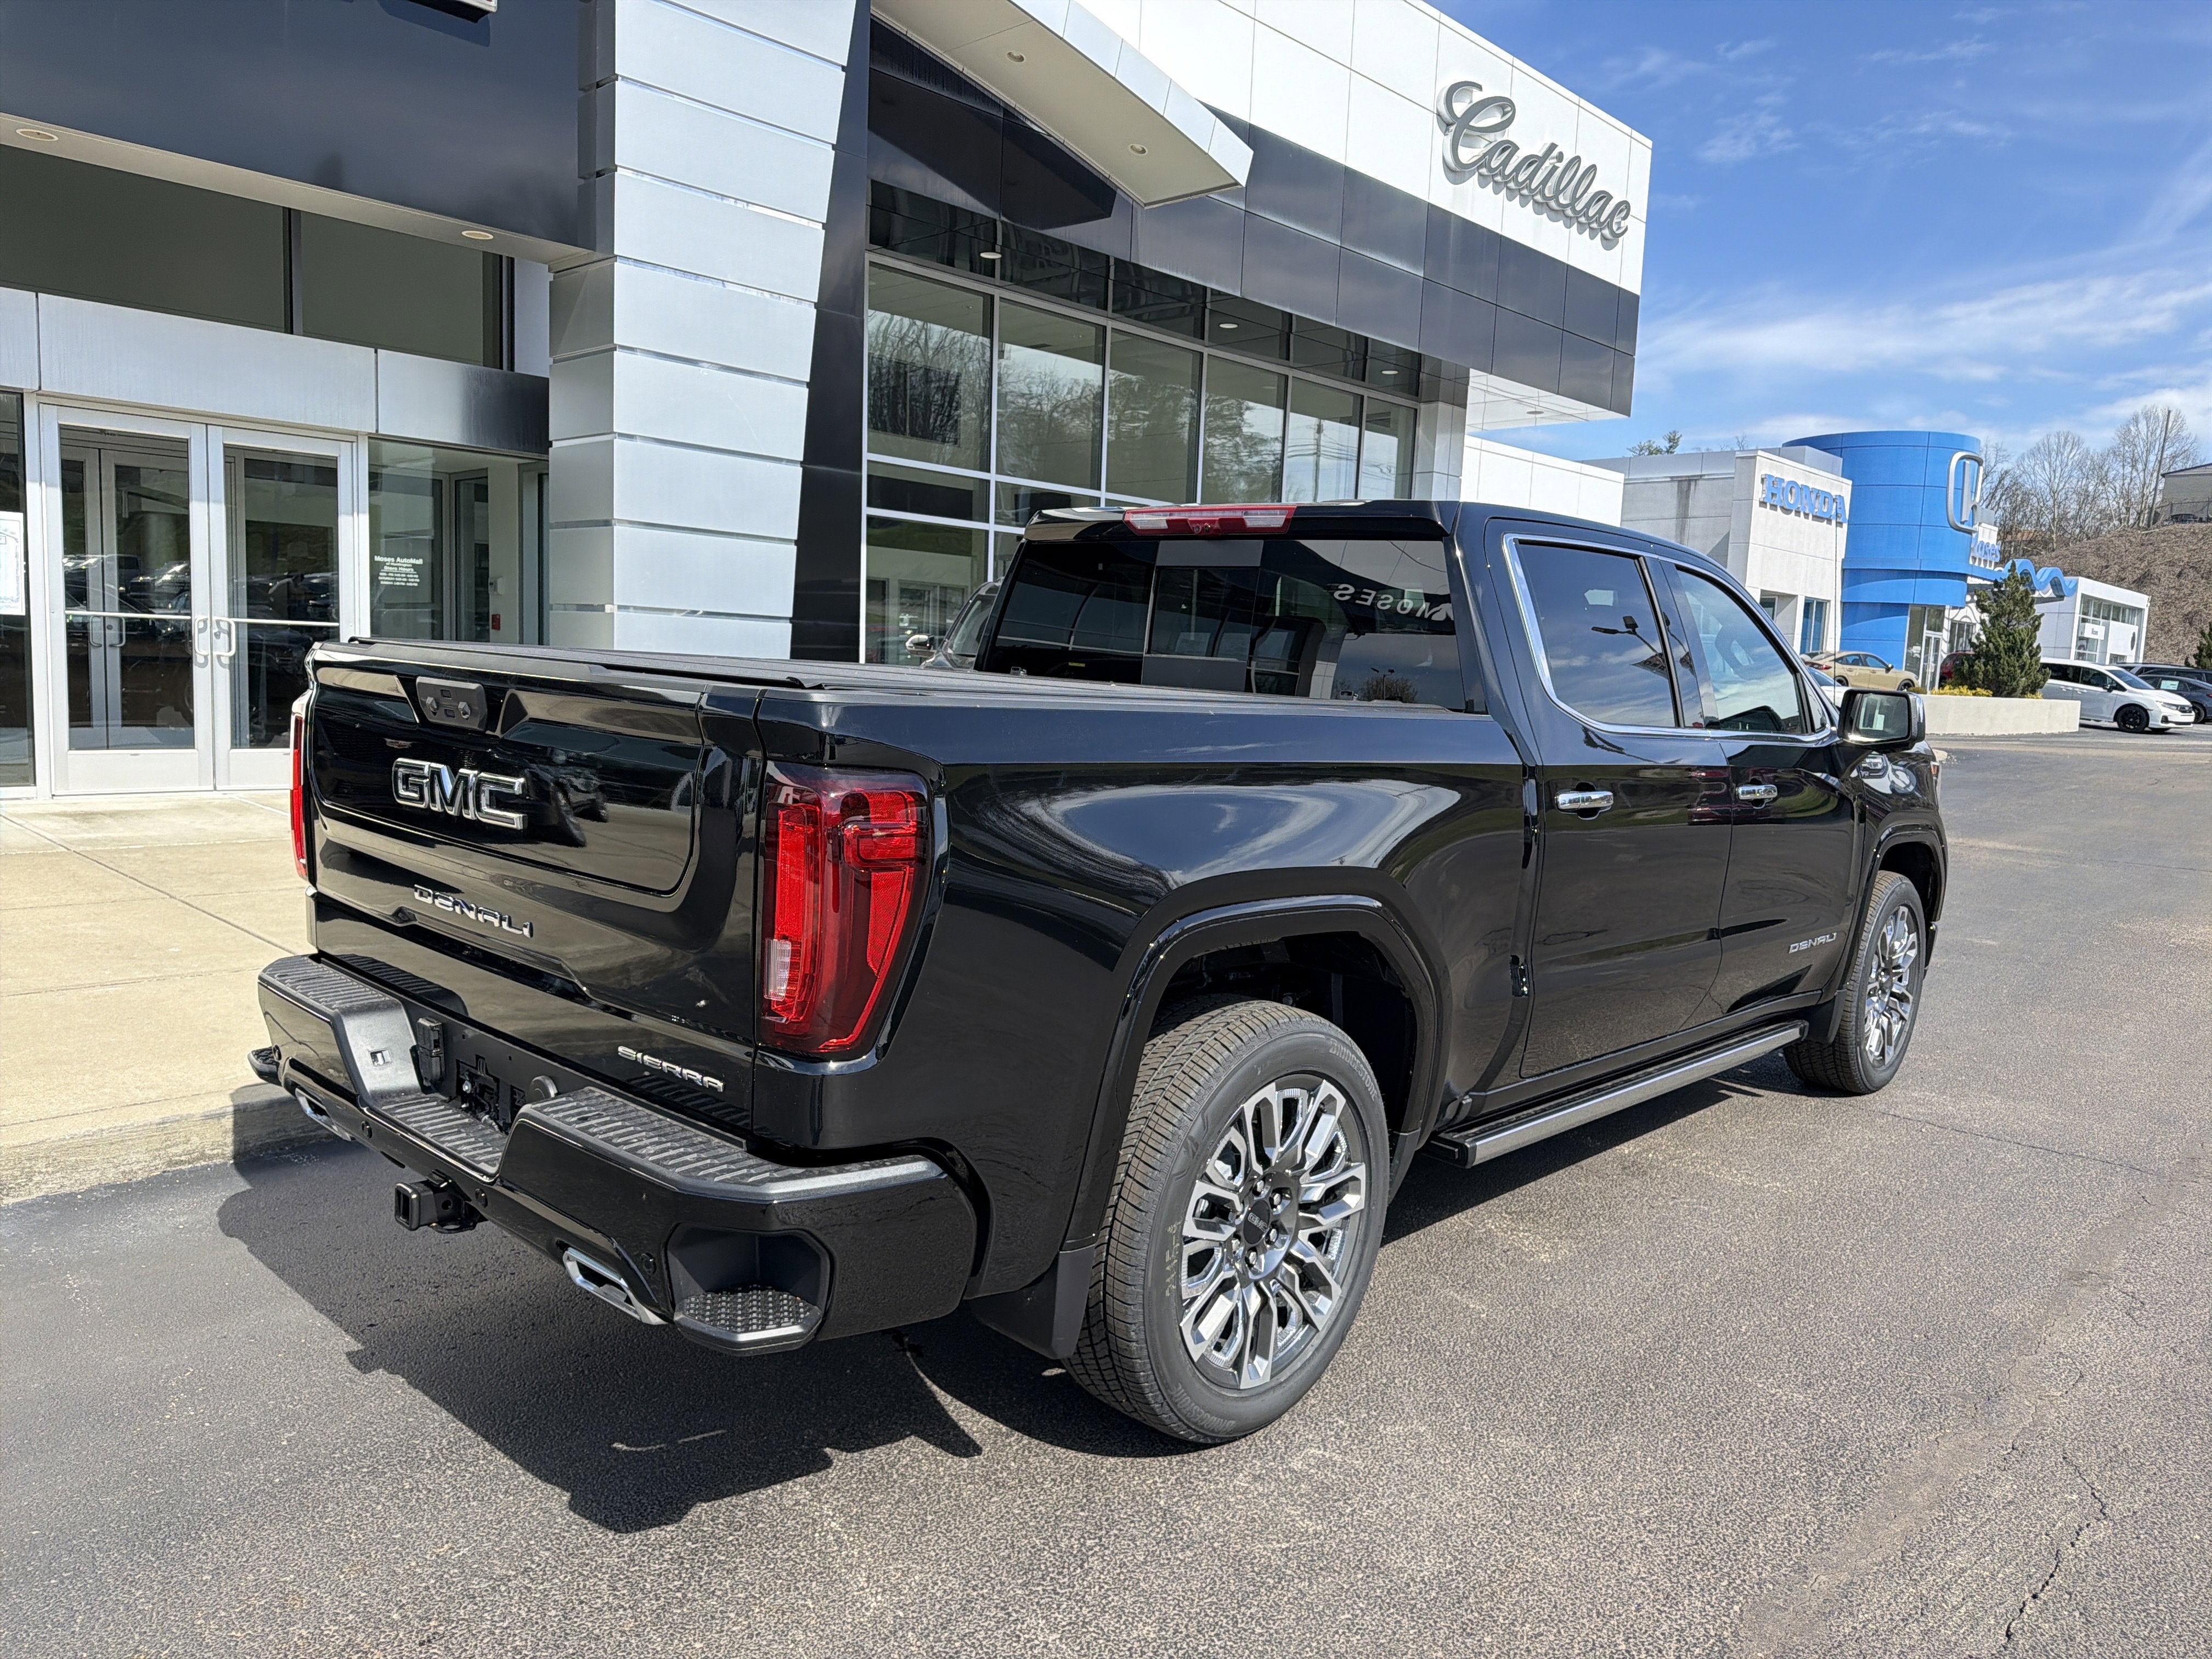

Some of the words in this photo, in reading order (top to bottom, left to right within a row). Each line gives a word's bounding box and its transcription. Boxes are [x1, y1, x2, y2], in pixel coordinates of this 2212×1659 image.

[1437, 81, 1631, 239] Cadillac
[1760, 474, 1848, 524] HONDA
[392, 758, 528, 830] GMC
[414, 884, 534, 939] DENALI
[1788, 932, 1837, 954] DENALI
[618, 1046, 725, 1092] SIERRA
[1329, 1038, 1378, 1102] BRIDGESTONE
[1248, 1212, 1268, 1233] GMC
[1167, 1383, 1237, 1435] BRIDGESTONE
